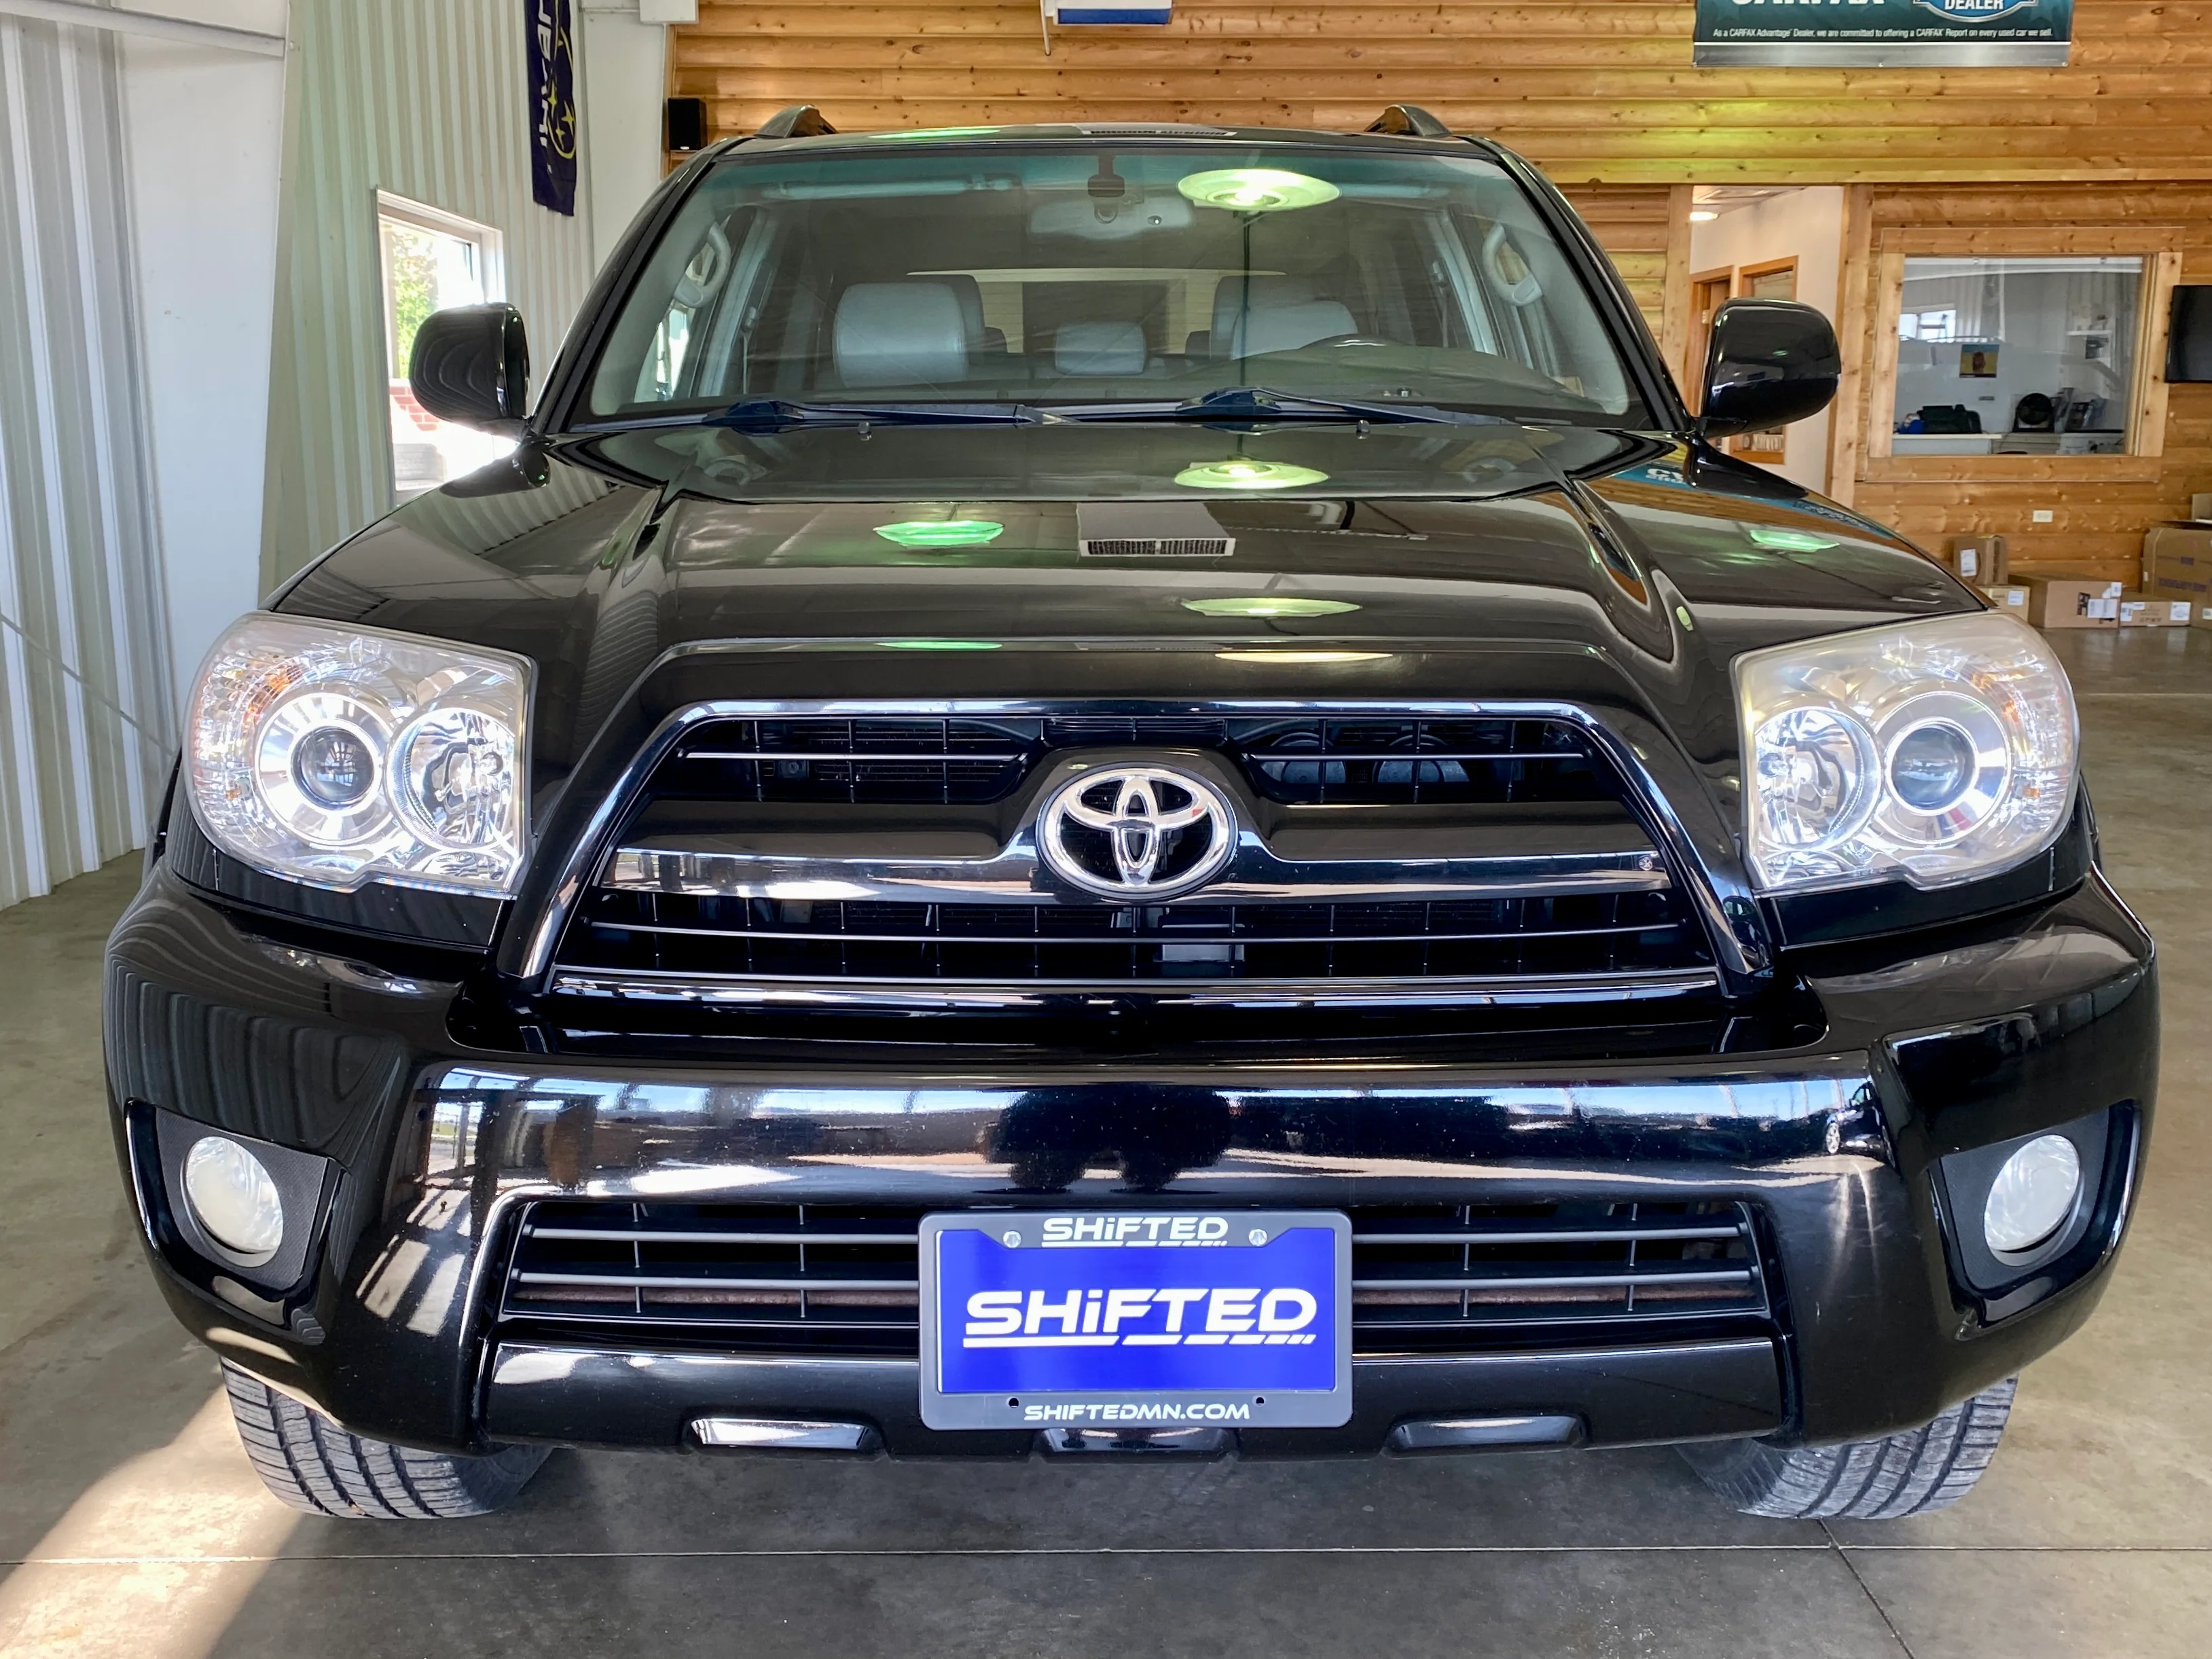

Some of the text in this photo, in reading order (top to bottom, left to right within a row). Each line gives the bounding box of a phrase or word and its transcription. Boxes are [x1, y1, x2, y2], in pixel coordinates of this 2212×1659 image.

[1944, 0, 2004, 10] DEALER
[1713, 29, 1722, 37] As
[1730, 29, 1756, 37] CARFAX
[1794, 29, 1815, 37] Dealer,
[1883, 29, 1908, 38] offering
[1916, 29, 1942, 37] CARFAX
[1946, 29, 1968, 37] Report
[1999, 29, 2014, 37] used
[2039, 29, 2053, 37] sell.
[1023, 1404, 1250, 1421] SHIFTEDMN.COM
